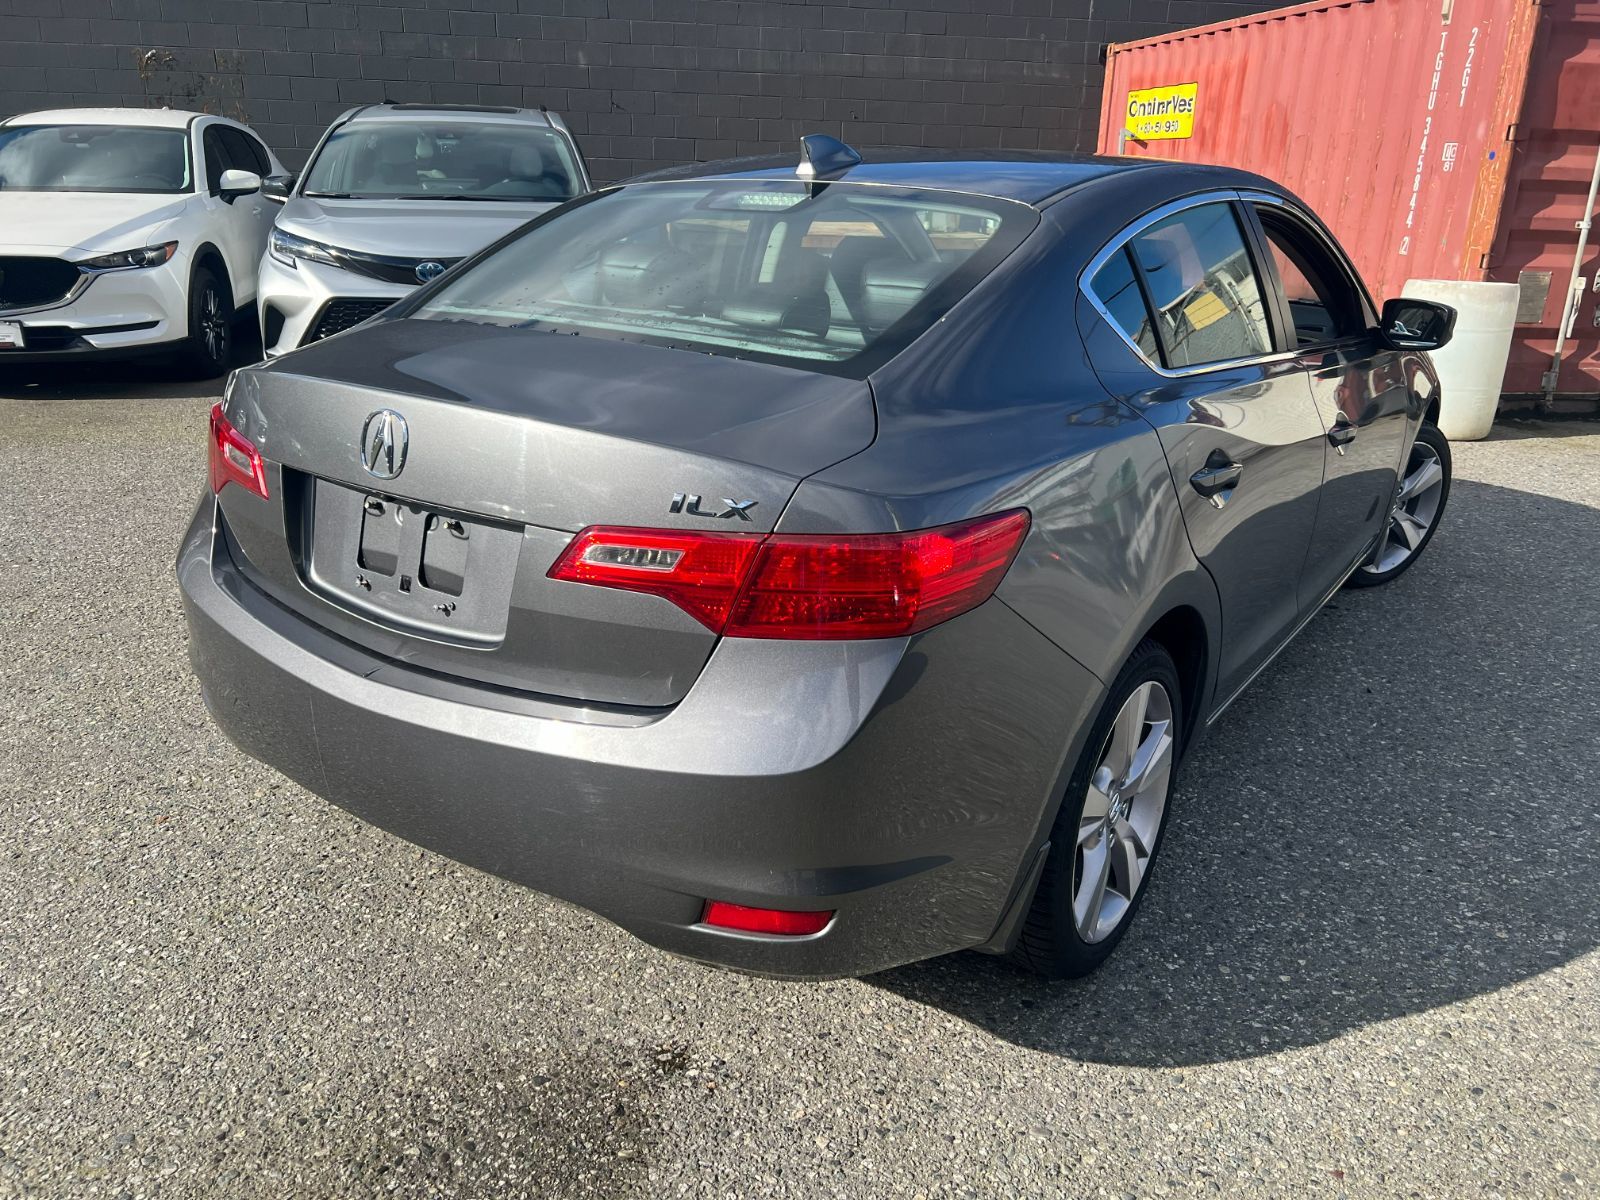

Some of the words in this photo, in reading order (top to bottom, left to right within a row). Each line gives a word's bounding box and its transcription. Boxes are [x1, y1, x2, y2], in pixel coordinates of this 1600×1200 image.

[1428, 31, 1448, 110] TGHU
[1459, 27, 1479, 107] 22G1
[1405, 116, 1432, 229] 345844
[1442, 161, 1454, 172] 81
[1399, 235, 1410, 256] 2
[668, 492, 759, 522] ILX
